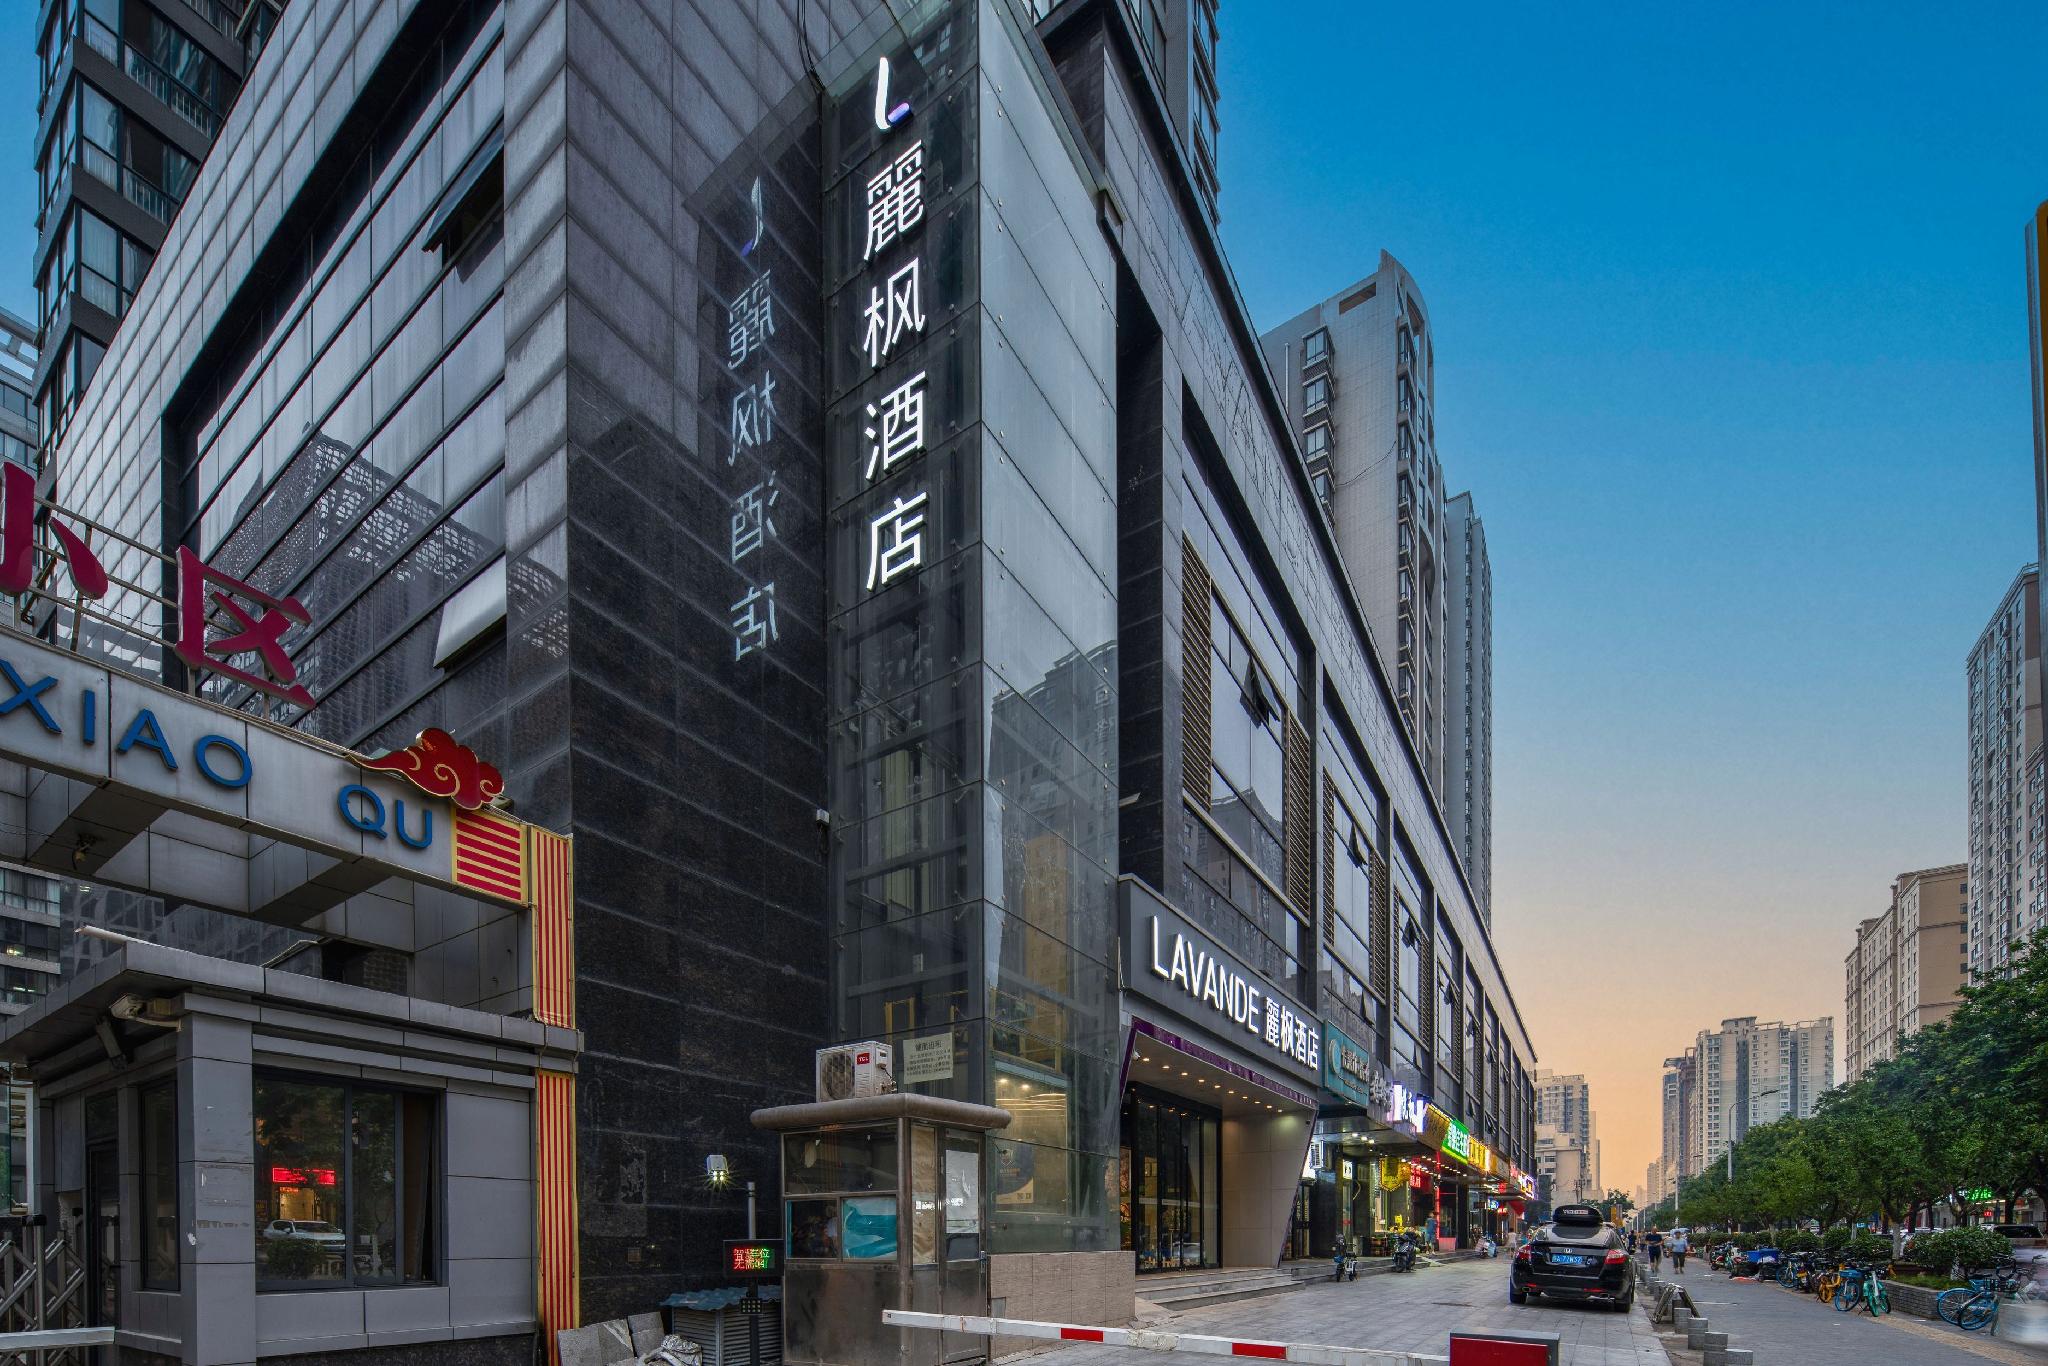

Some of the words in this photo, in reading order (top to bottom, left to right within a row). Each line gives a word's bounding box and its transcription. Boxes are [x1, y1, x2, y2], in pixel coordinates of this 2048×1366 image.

[863, 139, 927, 591] 麗枫酒店
[0, 659, 254, 788] XIAO
[338, 783, 434, 849] QU
[1152, 915, 1260, 1034] LAVANDE
[1265, 996, 1319, 1071] 麗枫酒店
